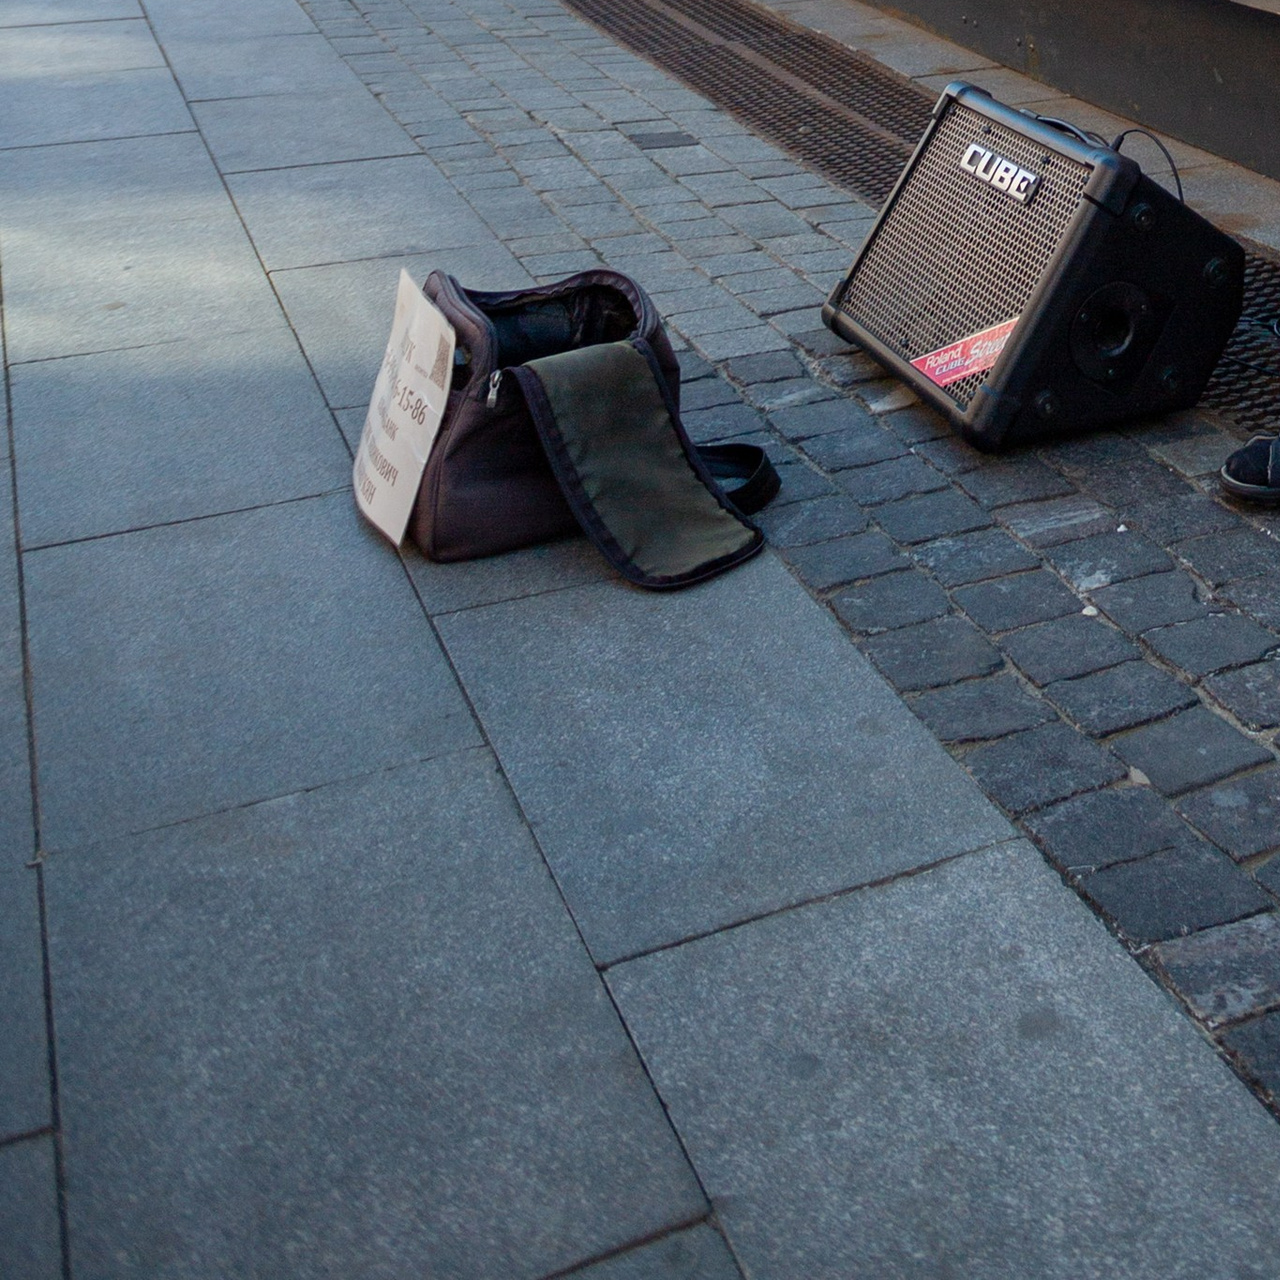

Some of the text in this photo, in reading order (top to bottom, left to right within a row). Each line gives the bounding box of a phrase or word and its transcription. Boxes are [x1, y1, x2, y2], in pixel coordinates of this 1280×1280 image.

[960, 143, 1037, 203] CUBE
[925, 344, 963, 370] Roland
[935, 357, 965, 376] CUBE
